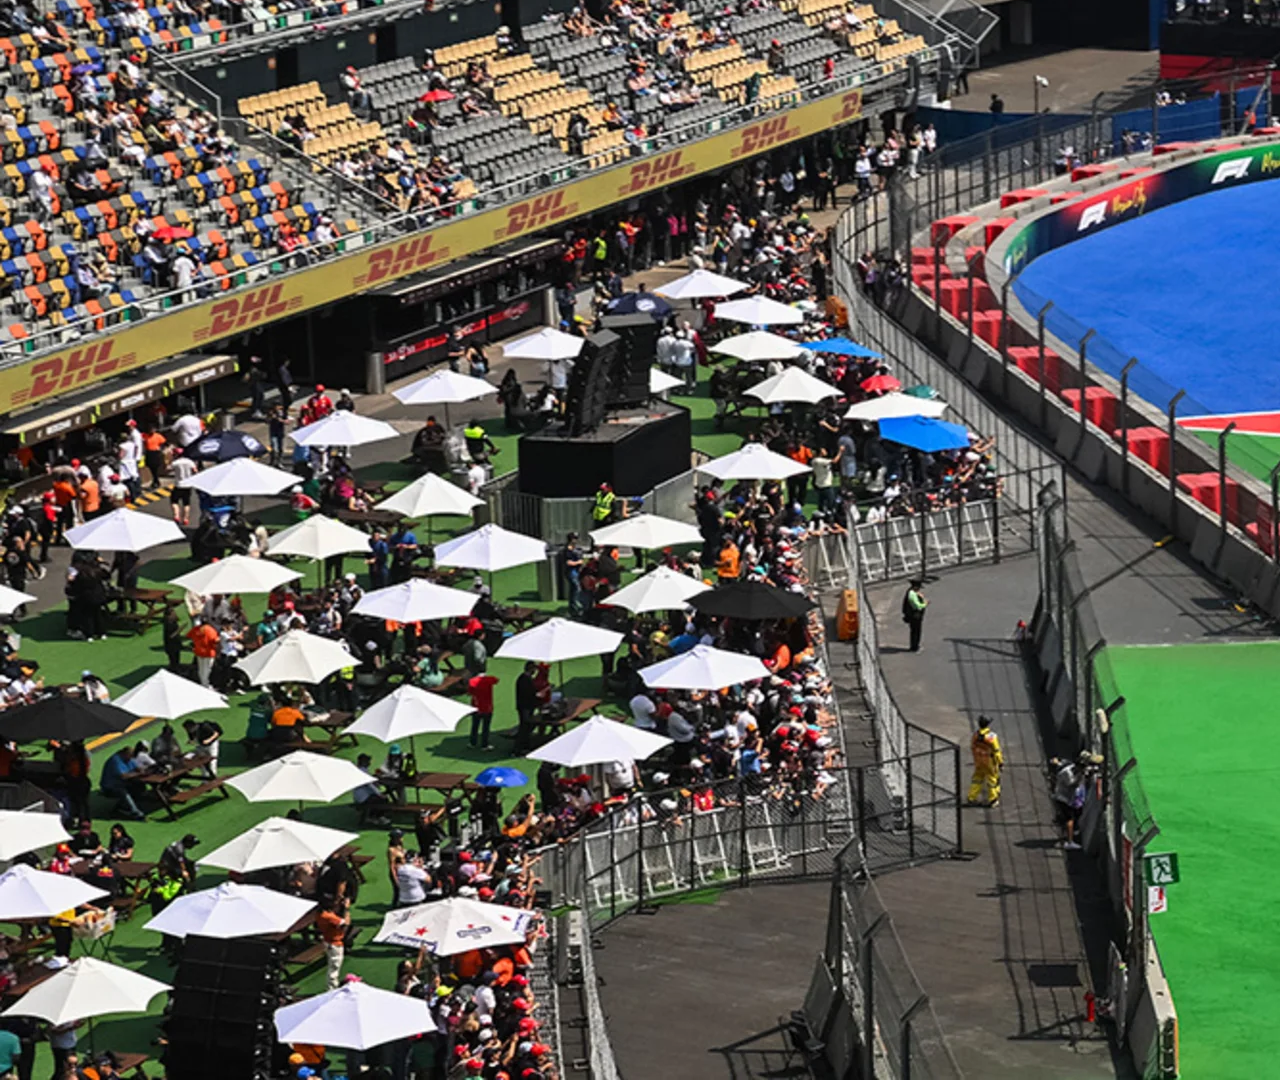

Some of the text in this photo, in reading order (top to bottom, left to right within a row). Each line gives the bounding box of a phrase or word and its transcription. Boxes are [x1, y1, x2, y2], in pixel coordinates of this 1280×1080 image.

[740, 115, 790, 156] DHL
[629, 151, 685, 192] DHL
[507, 191, 568, 232] DHL
[366, 235, 438, 283] DHL
[208, 283, 293, 336] DHL
[29, 339, 123, 400] DHL
